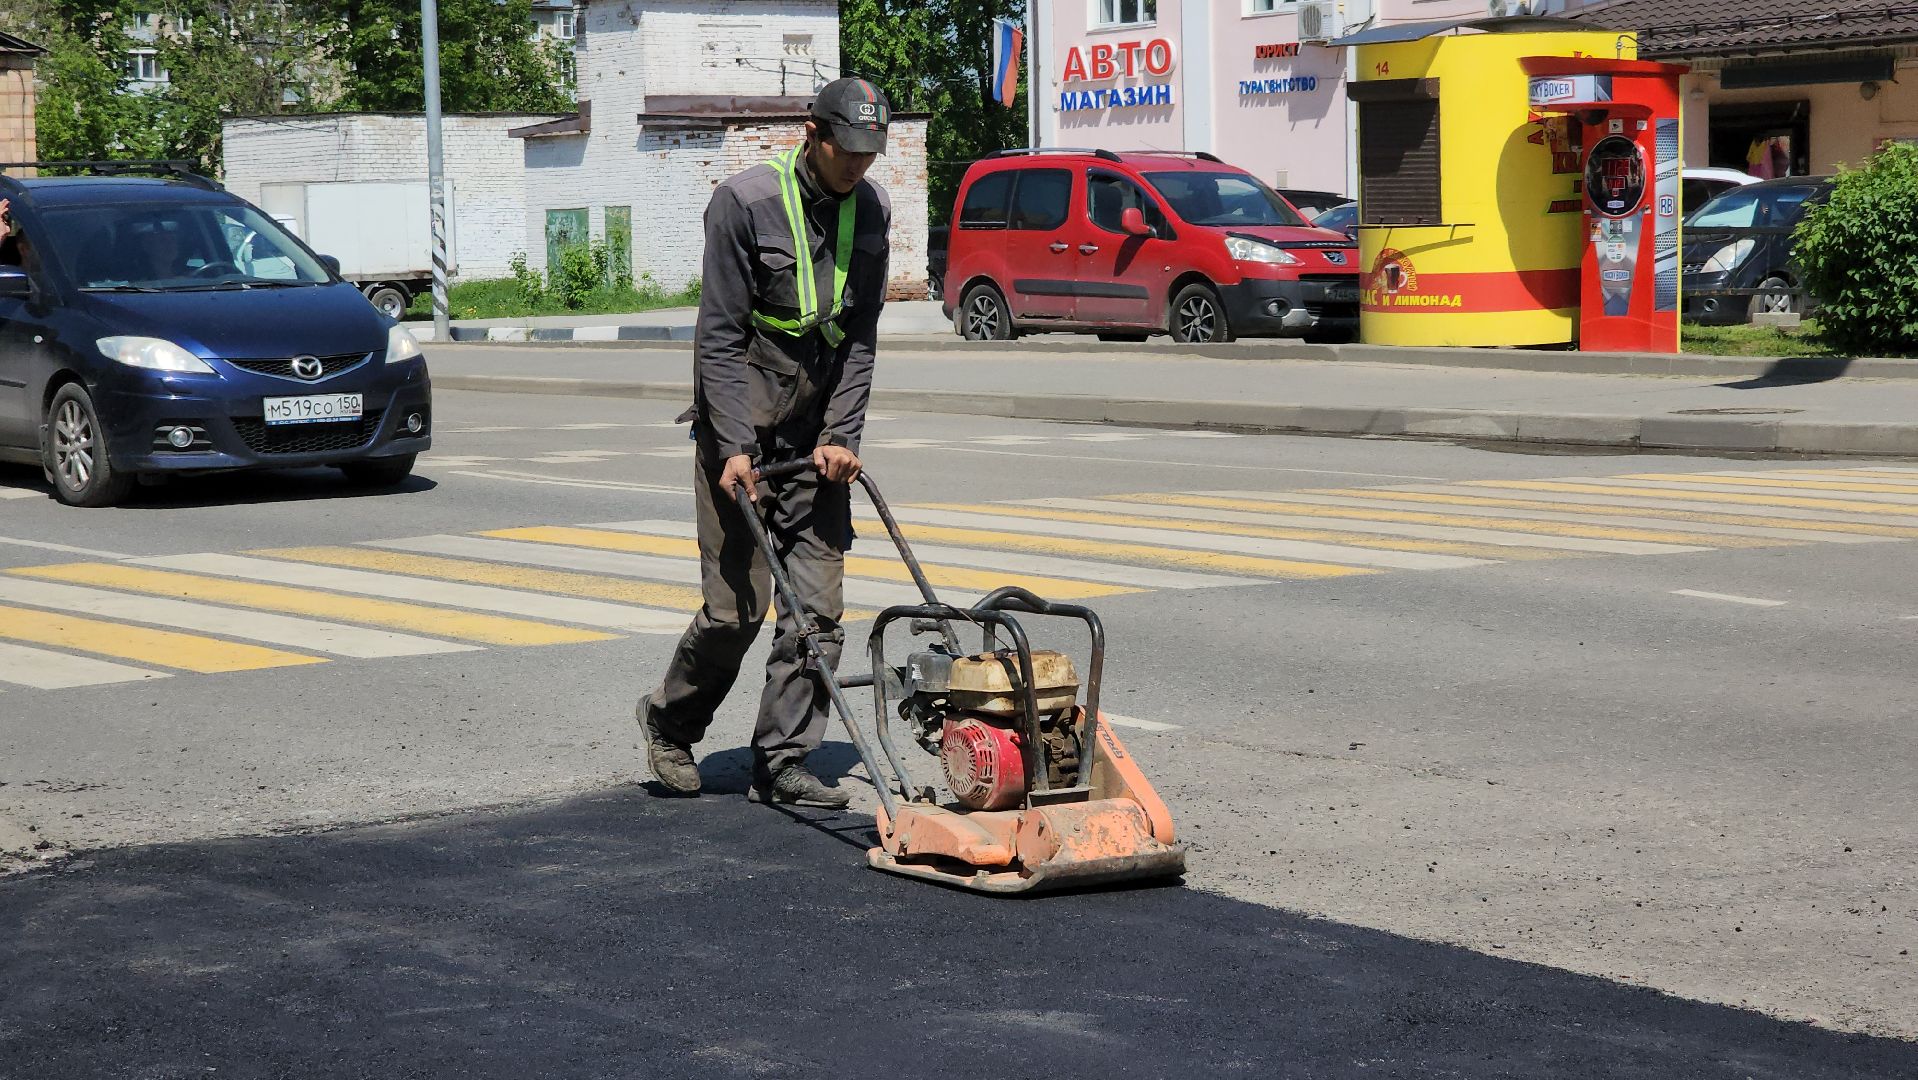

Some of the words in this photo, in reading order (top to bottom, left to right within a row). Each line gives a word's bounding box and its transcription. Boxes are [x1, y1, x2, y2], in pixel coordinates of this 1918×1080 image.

[1255, 42, 1300, 59] ЮРИСТ
[1063, 38, 1174, 82] АВТО
[1375, 61, 1390, 77] 14
[1238, 76, 1317, 95] ТУРАГЕНТСТВО
[1544, 82, 1570, 97] BOXER
[1060, 84, 1172, 112] МАГАЗИН
[1660, 198, 1673, 214] RB
[1393, 294, 1462, 307] ЛИМОНАД
[336, 396, 359, 410] 150
